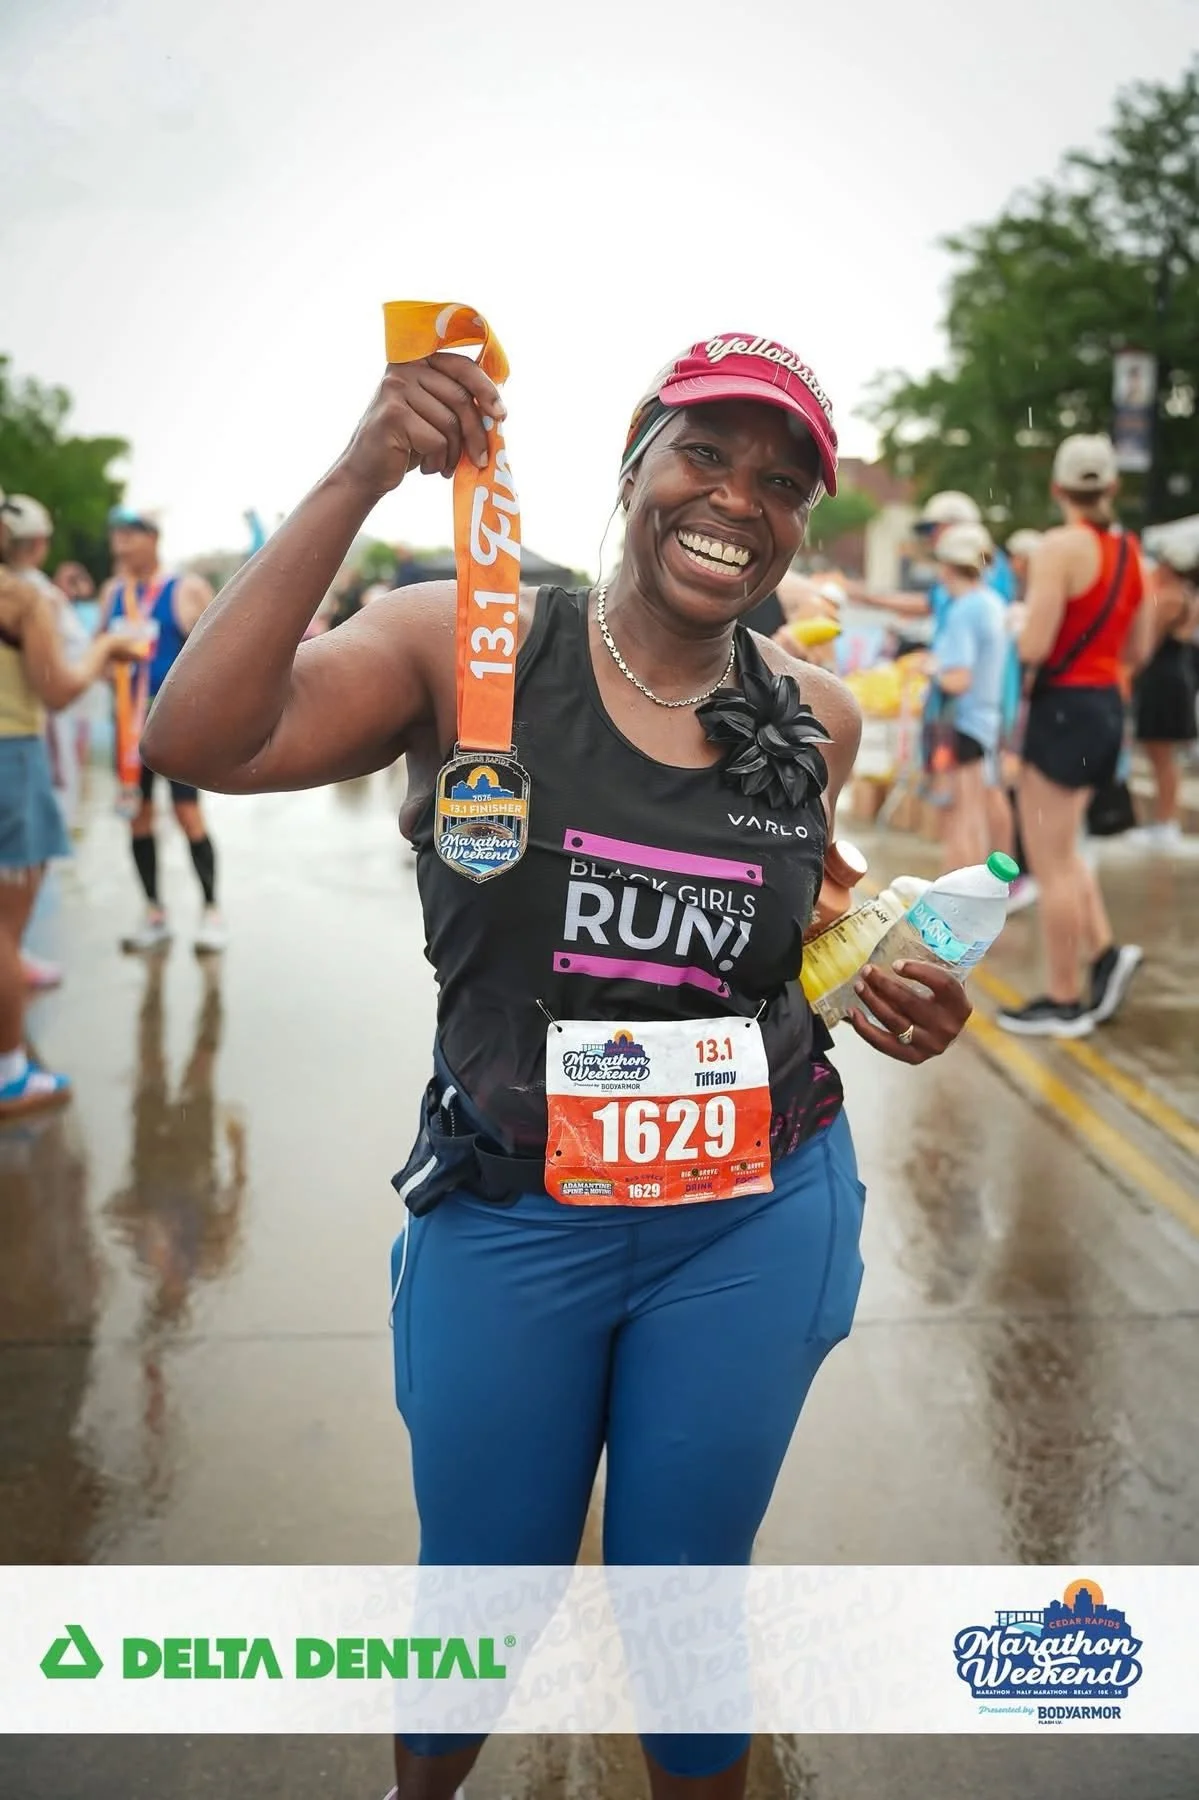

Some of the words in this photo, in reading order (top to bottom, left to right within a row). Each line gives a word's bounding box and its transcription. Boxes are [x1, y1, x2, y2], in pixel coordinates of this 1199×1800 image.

[469, 589, 517, 680] 13.1
[472, 794, 492, 803] 2026
[449, 804, 467, 814] 13.1
[469, 804, 522, 814] FINISHER
[727, 813, 809, 839] VARLO
[440, 833, 520, 850] Marathon
[441, 845, 521, 861] Weekend
[677, 884, 757, 919] GIRLS
[562, 880, 753, 972] RUN!
[563, 1052, 650, 1066] Marathon
[695, 1037, 734, 1064] 13.1
[564, 1064, 650, 1081] Weekend
[694, 1070, 737, 1087] Tiffany
[592, 1095, 736, 1164] 1629
[627, 1183, 661, 1199] 1629
